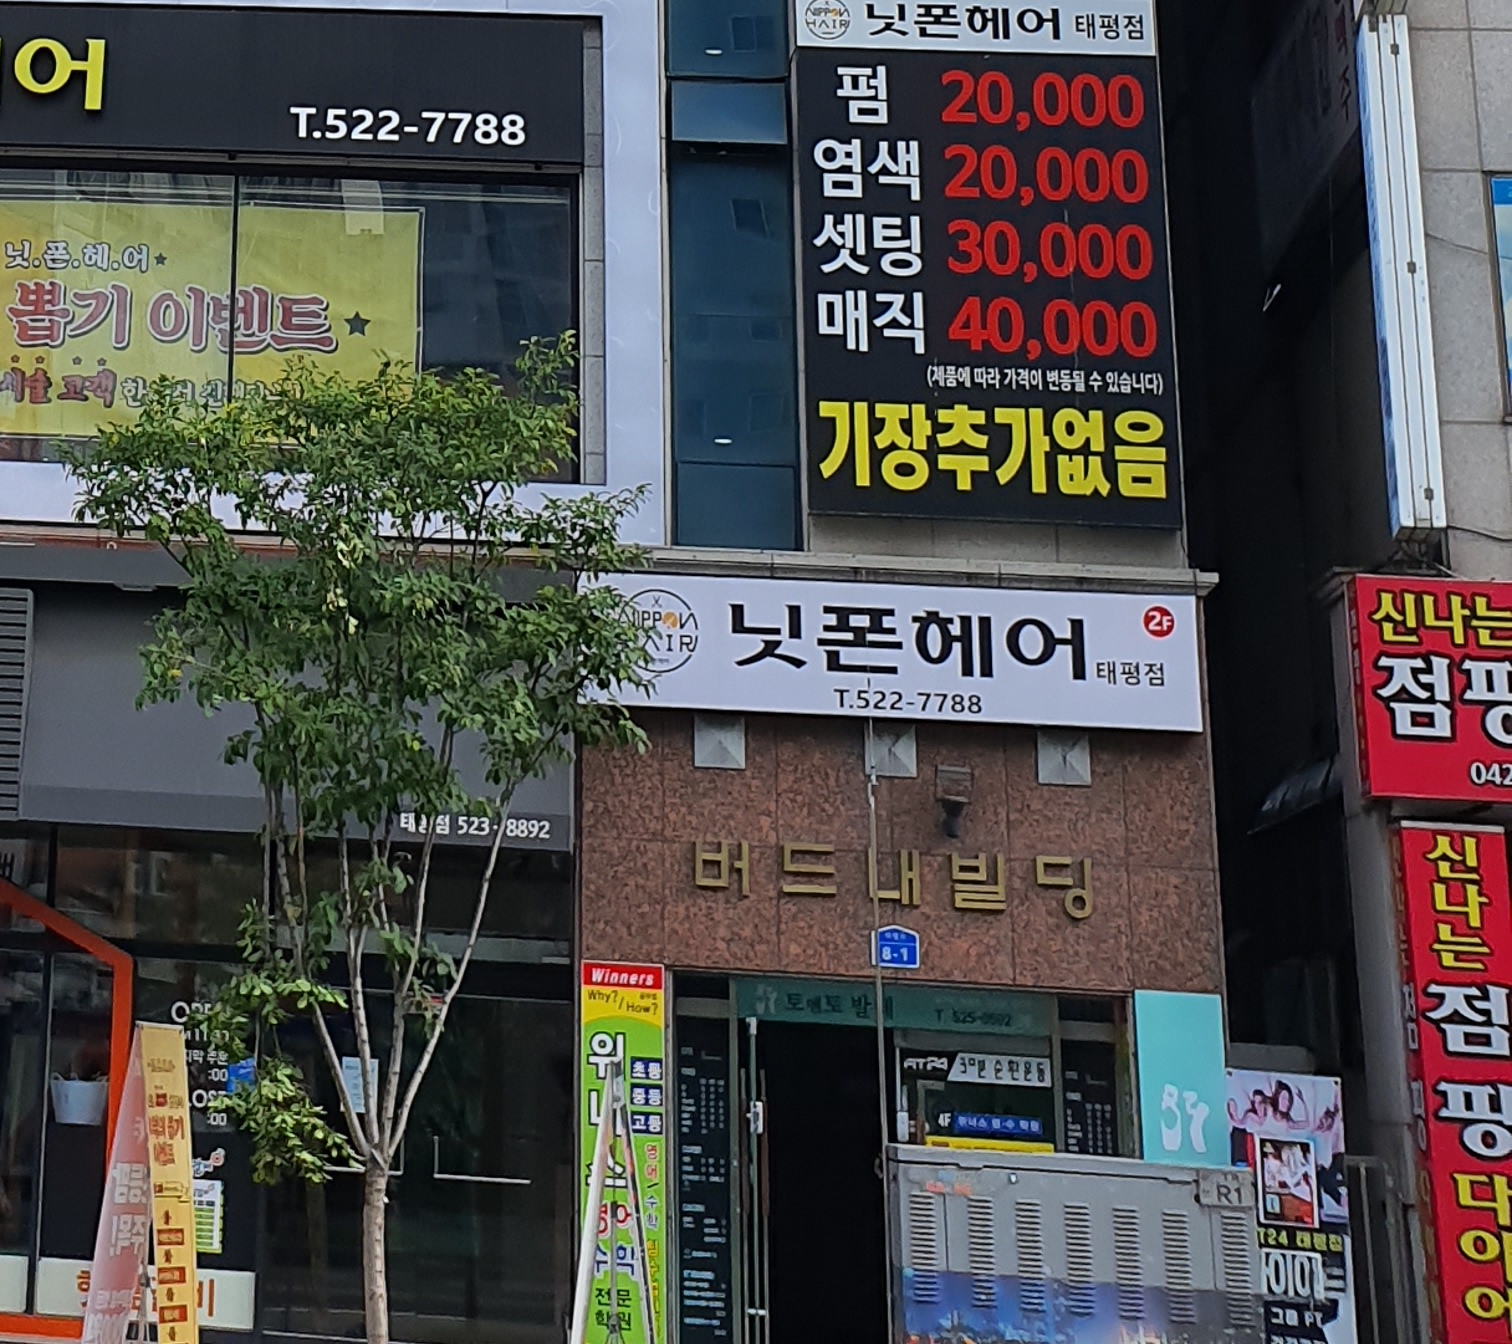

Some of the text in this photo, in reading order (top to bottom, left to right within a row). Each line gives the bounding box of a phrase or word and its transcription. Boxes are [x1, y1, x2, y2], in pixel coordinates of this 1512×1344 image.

[864, 1, 1146, 42] 닛폰헤어 태평점
[836, 63, 1146, 133] 펌 20,000
[289, 107, 527, 147] T.522-7788
[813, 138, 1150, 208] 염색 20,000
[813, 213, 1155, 284] 셋팅 30,000
[4, 279, 133, 351] 뽑기
[147, 285, 339, 356] 이벤트
[816, 289, 1159, 360] 매직 40,000
[56, 369, 116, 408] 고객
[926, 365, 1165, 396] (제품에 따라 가격이 변동될 수 있습니다)
[1147, 610, 1175, 634] 2F
[1372, 591, 1512, 647] 신나는
[727, 602, 1167, 689] 닛폰헤어 태평점
[833, 686, 983, 715] T.522-7788
[1425, 834, 1492, 971] 신나는
[881, 945, 908, 962] 8-1
[591, 967, 655, 987] Winners
[1216, 1183, 1244, 1205] R1
